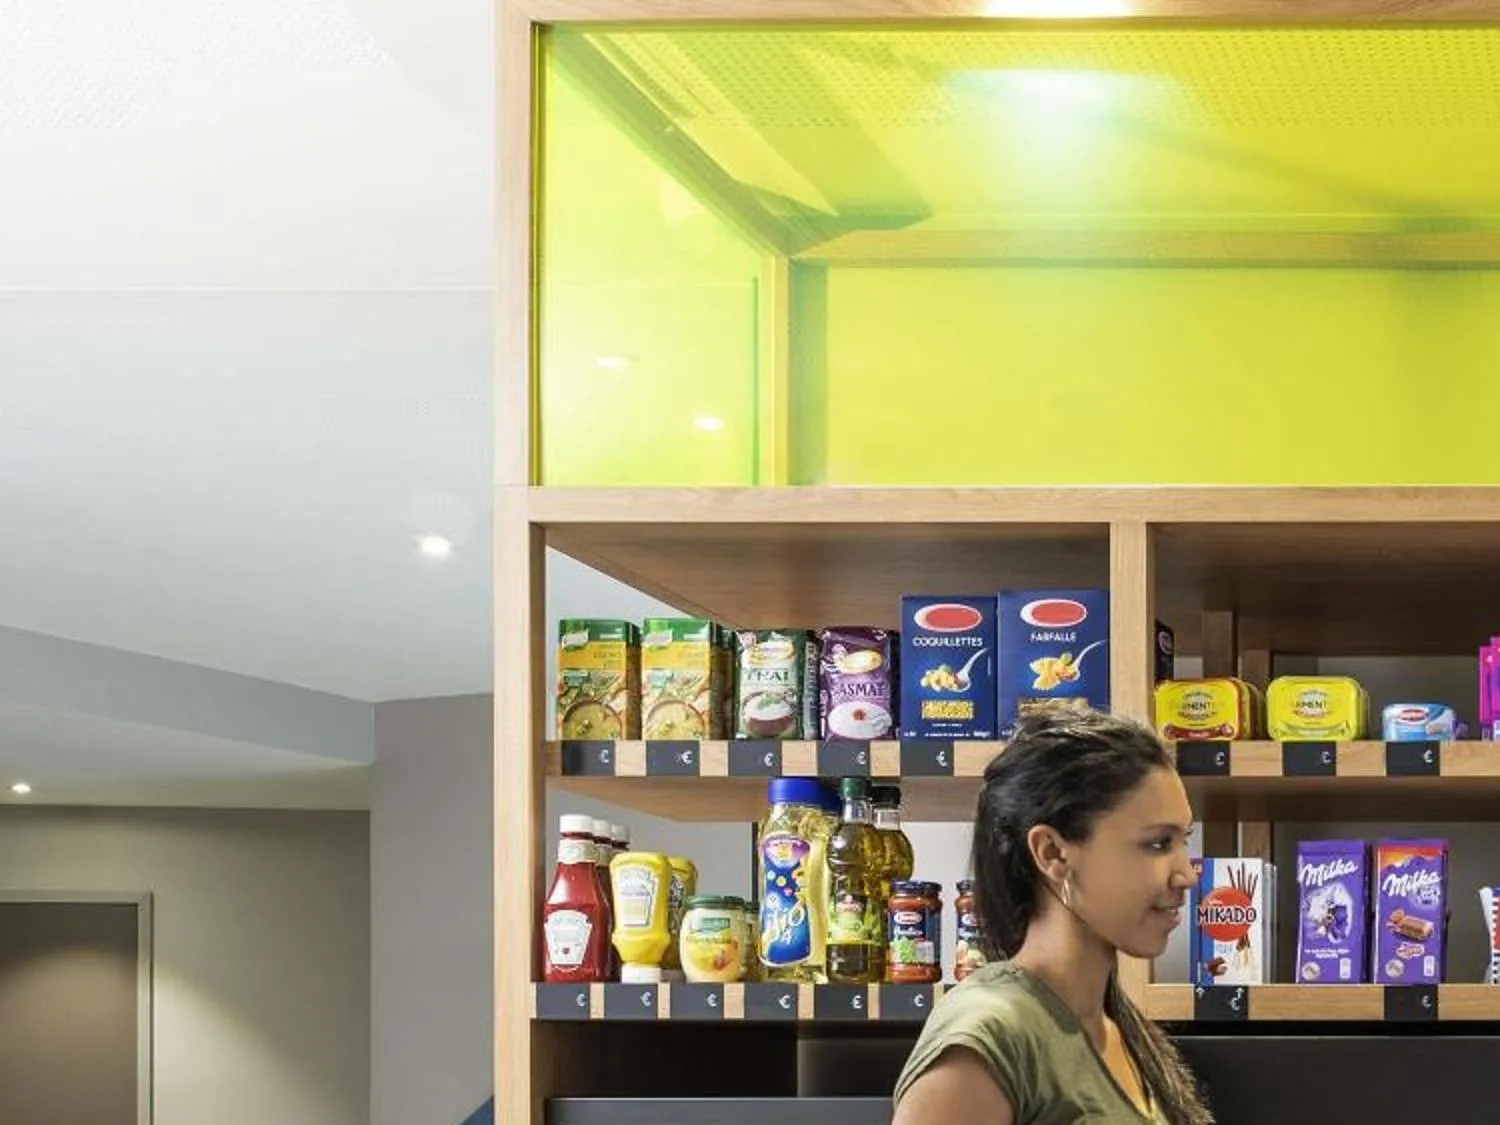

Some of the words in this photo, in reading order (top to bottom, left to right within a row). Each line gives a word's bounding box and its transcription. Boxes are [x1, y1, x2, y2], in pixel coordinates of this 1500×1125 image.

[912, 636, 983, 648] COQUILLETTES
[1029, 630, 1077, 643] FARFALLE
[1302, 857, 1359, 886] Milka
[1381, 869, 1441, 897] Milka
[1197, 907, 1257, 925] MIKADO
